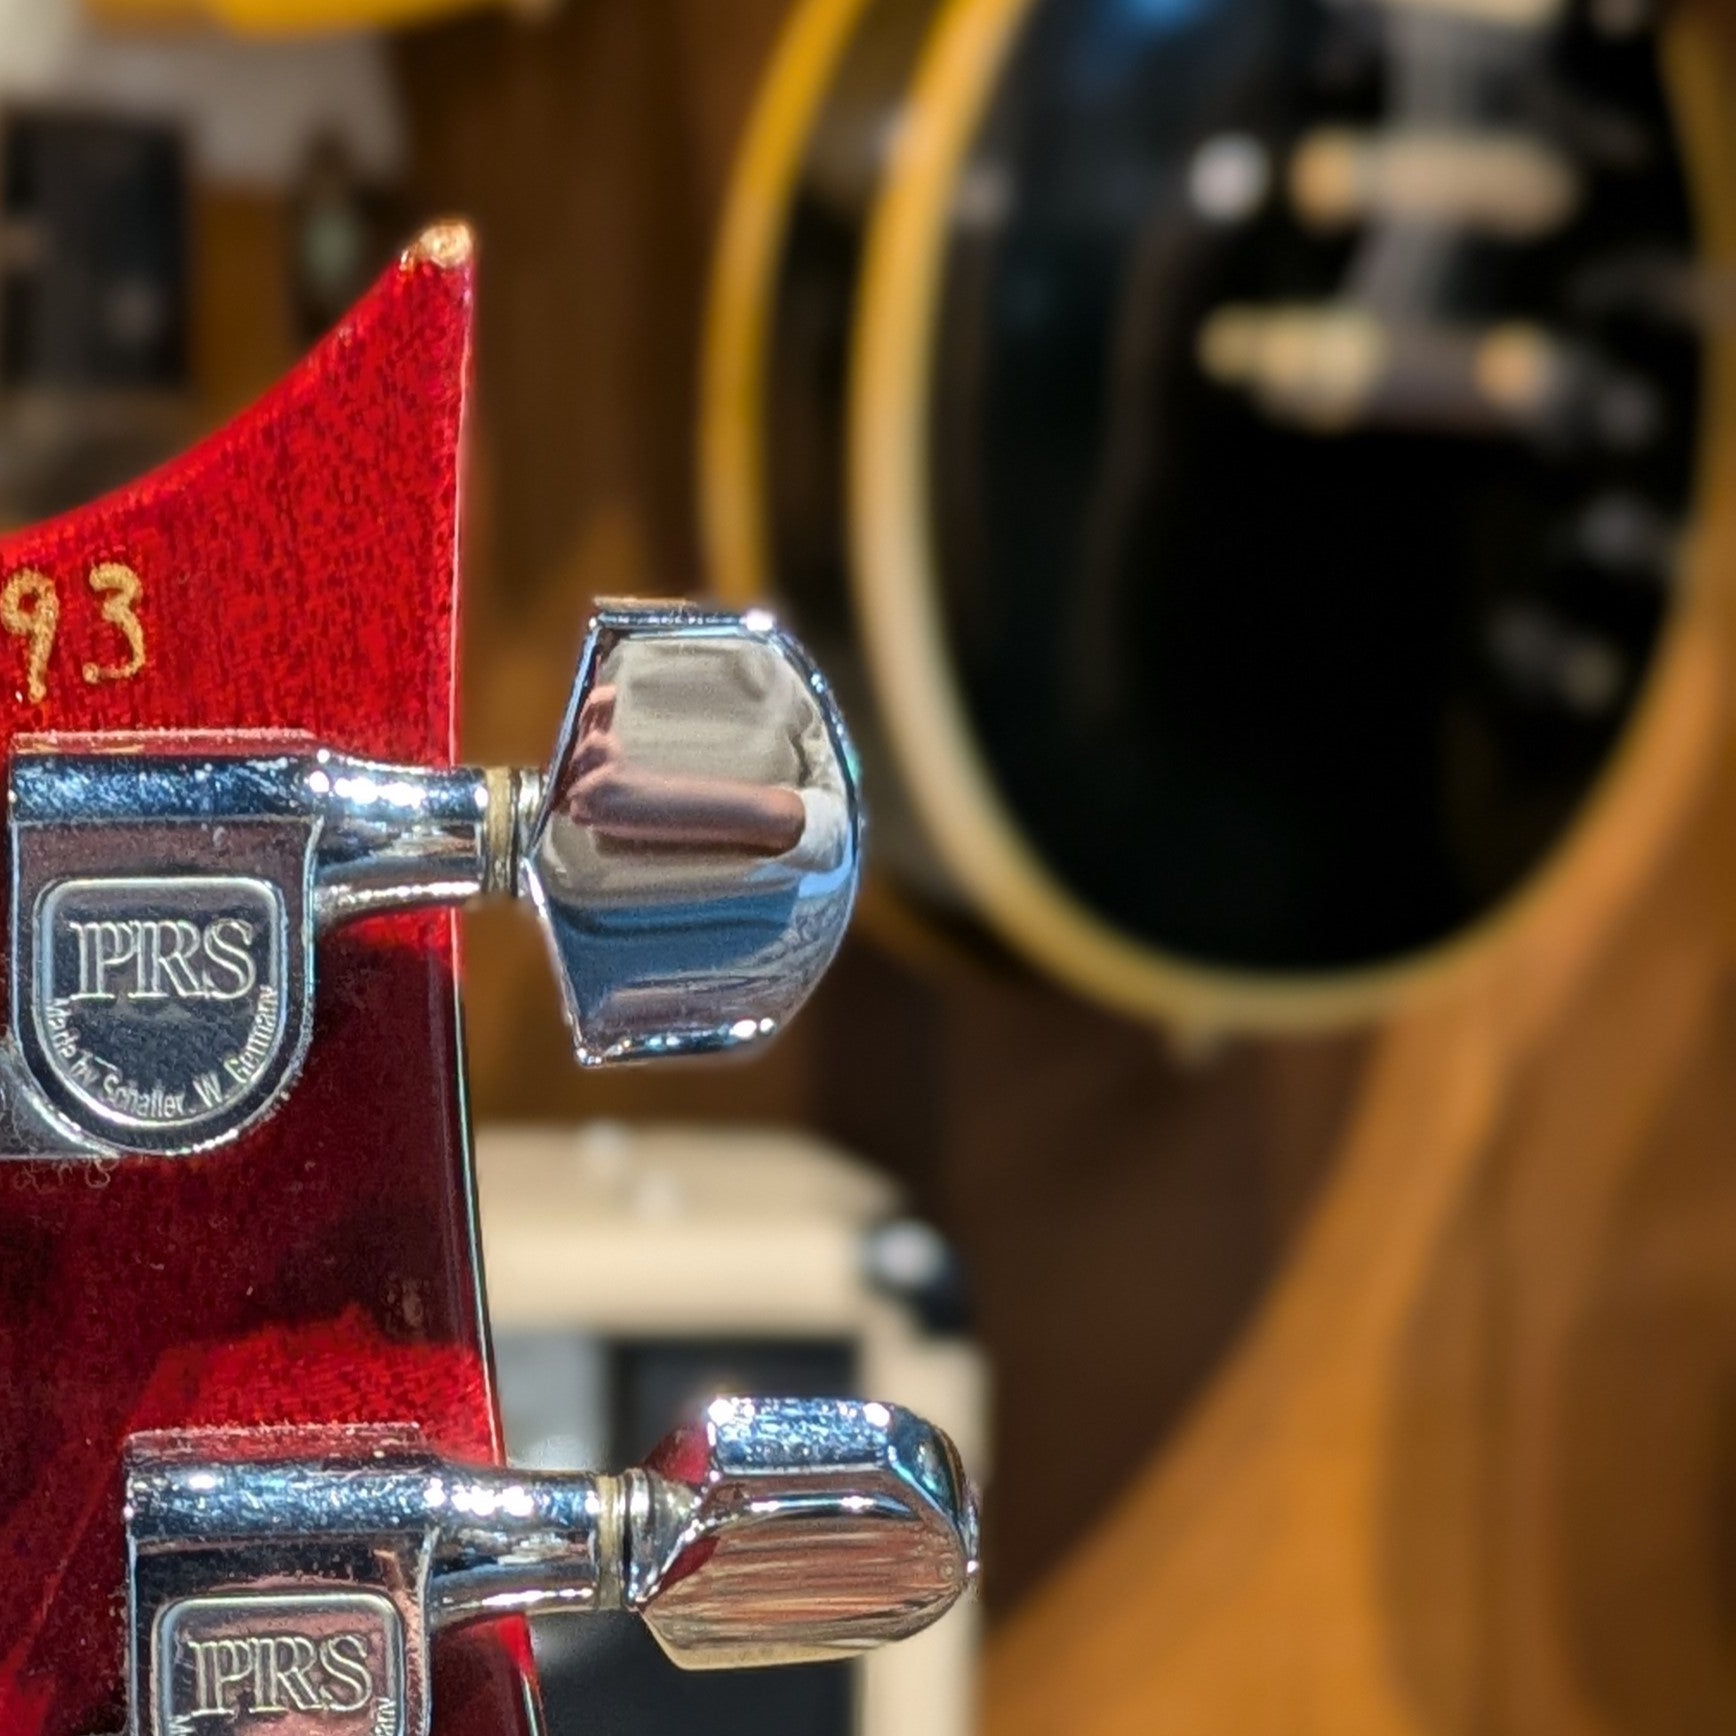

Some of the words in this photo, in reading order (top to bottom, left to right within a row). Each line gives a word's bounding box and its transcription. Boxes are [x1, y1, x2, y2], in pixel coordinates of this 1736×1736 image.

[68, 917, 257, 1000] PRS
[224, 984, 278, 1083] Germany
[187, 1635, 372, 1712] PRS
